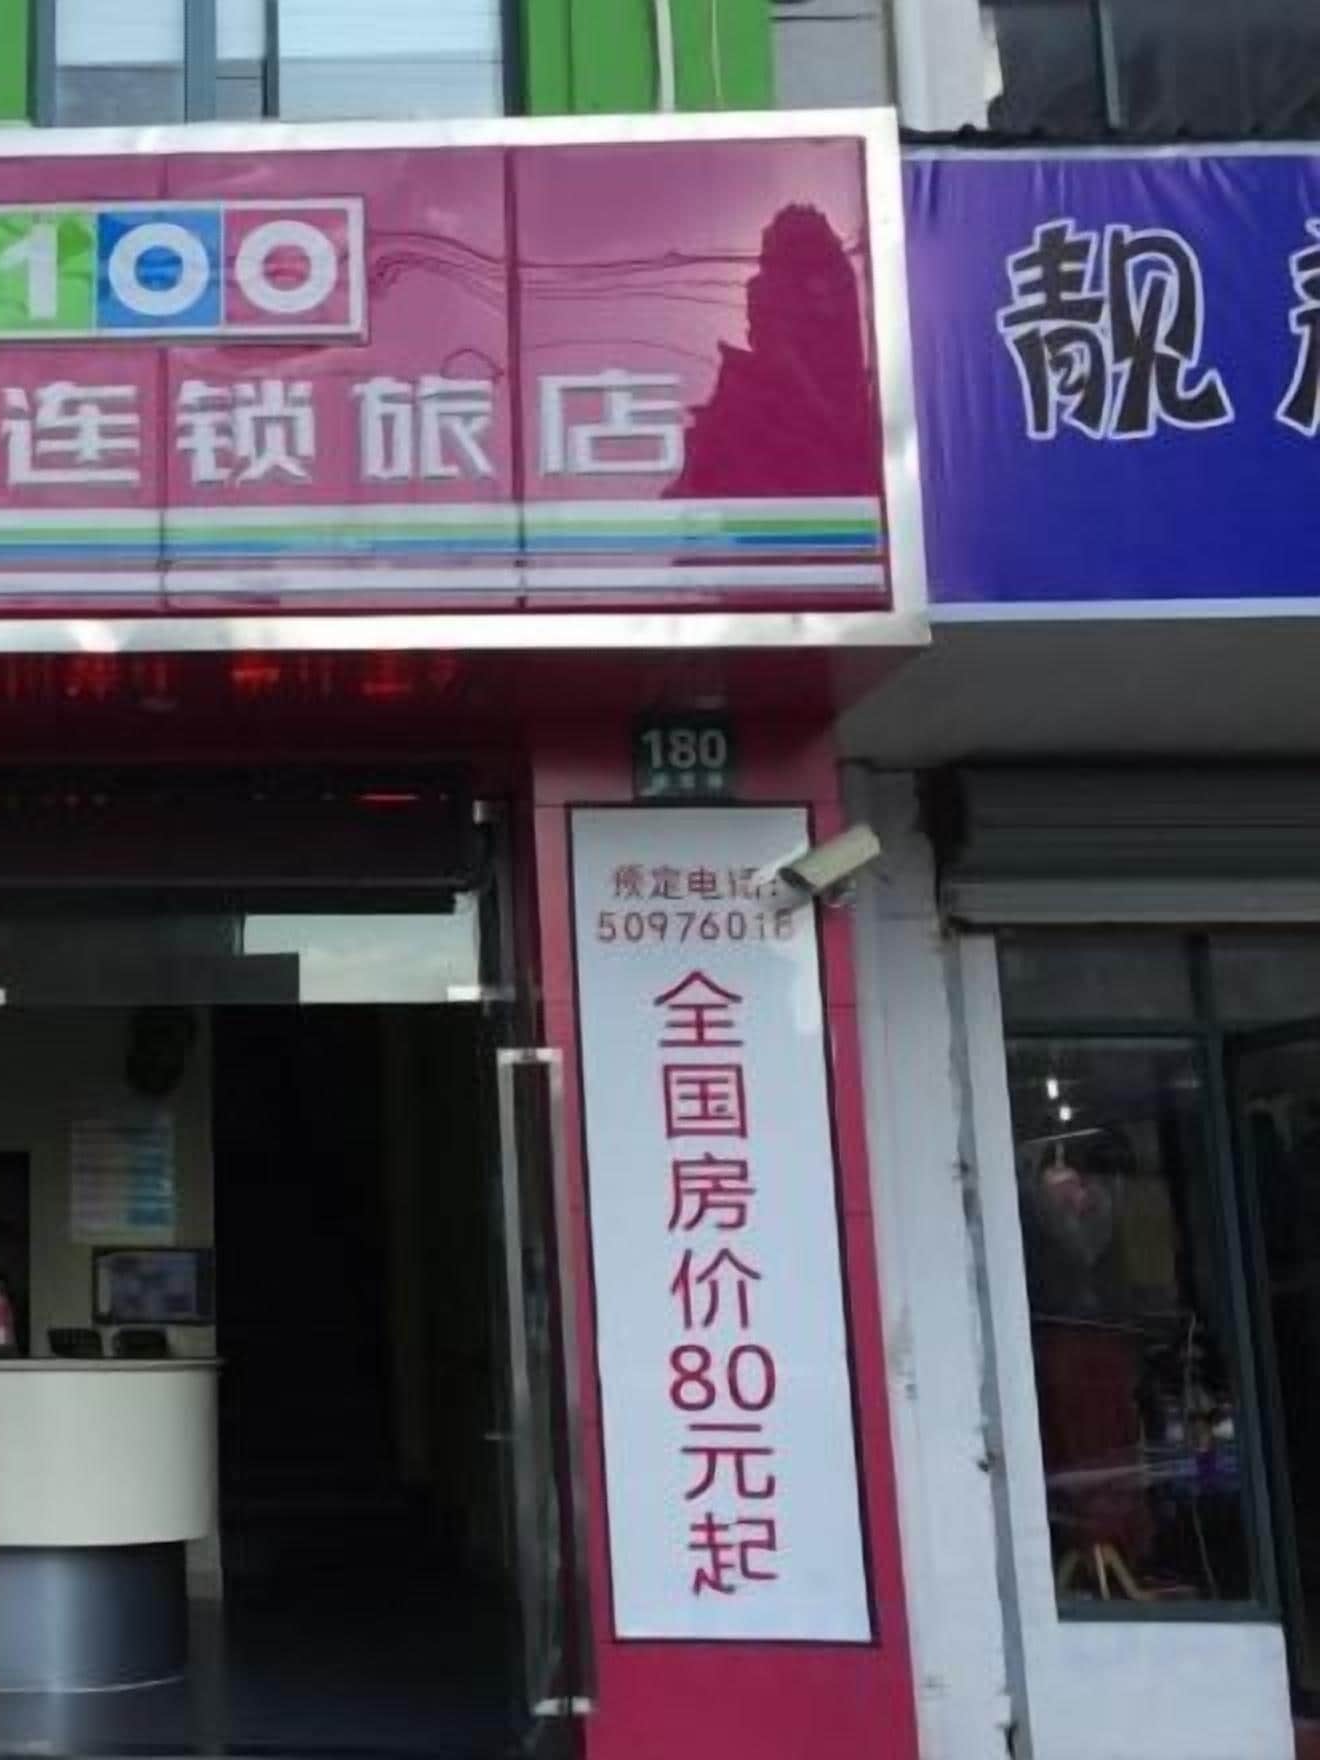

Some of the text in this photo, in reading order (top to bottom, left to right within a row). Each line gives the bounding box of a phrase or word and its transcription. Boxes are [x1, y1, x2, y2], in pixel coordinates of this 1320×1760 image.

[640, 727, 728, 769] 180
[653, 969, 779, 1597] 全国房价80元起
